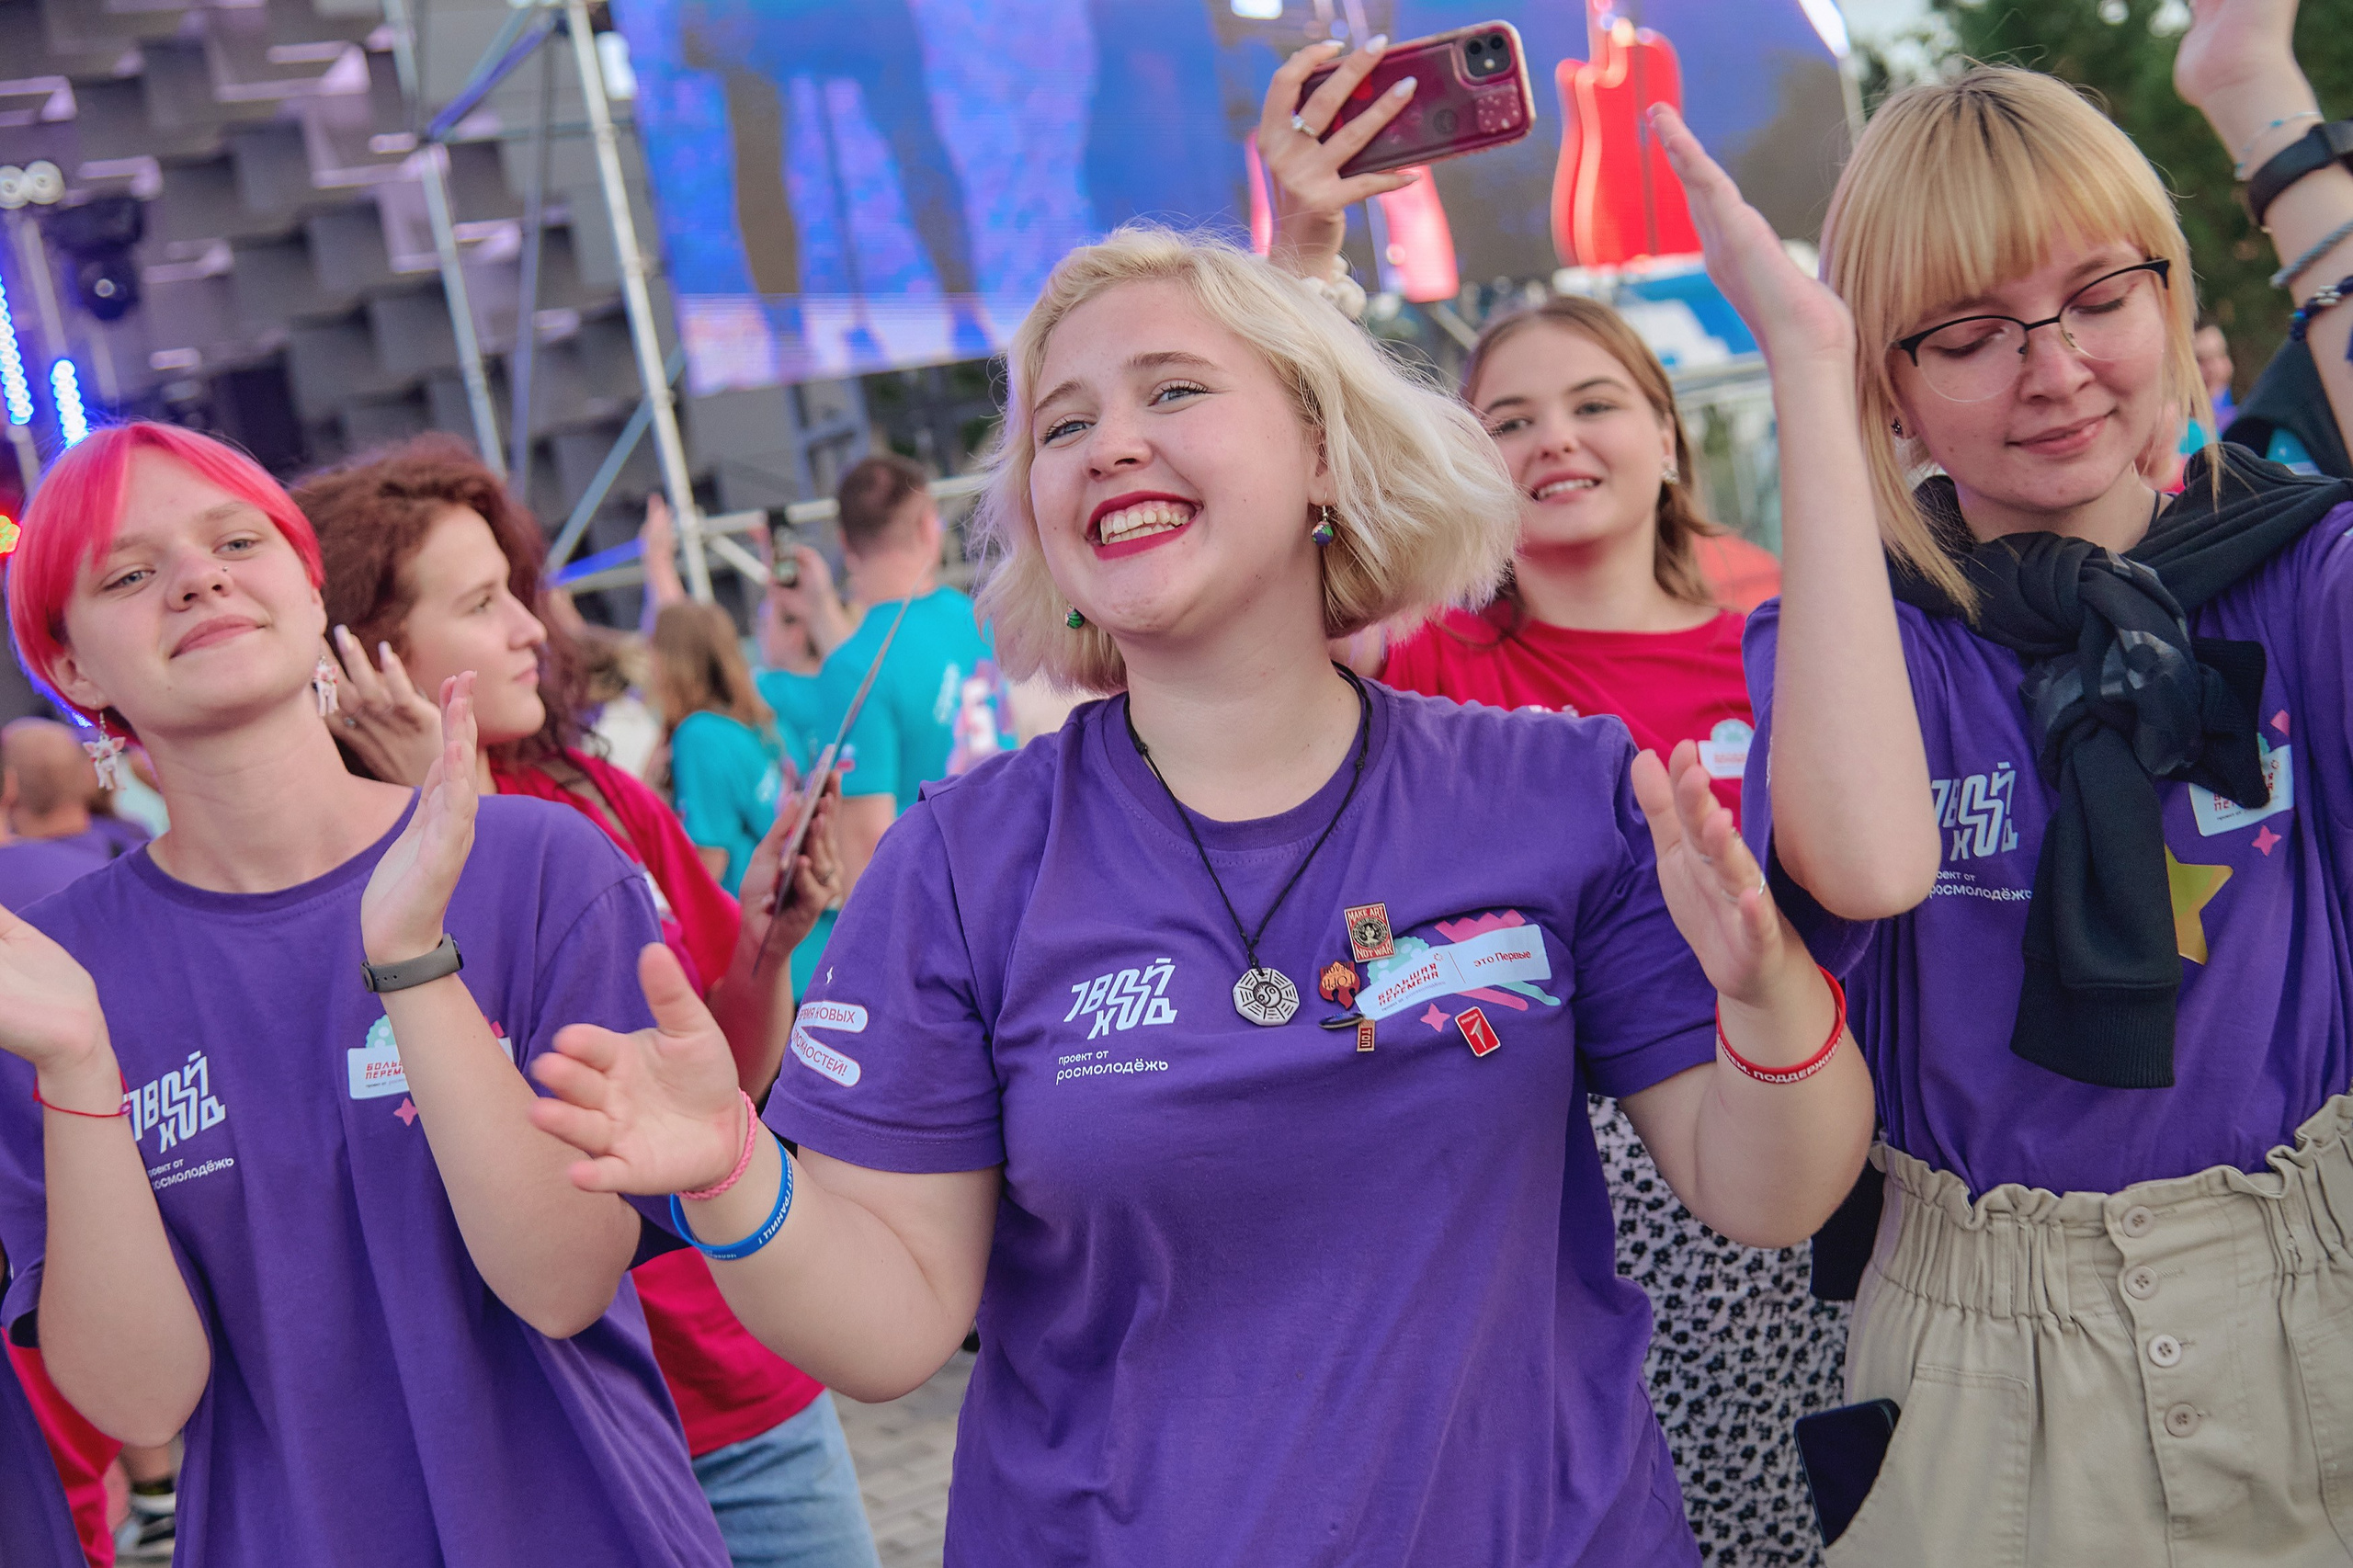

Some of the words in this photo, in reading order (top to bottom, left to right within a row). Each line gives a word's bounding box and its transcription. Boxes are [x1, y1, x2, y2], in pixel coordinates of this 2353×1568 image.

[1963, 873, 1975, 881] от
[1347, 908, 1368, 927] MAKE
[1370, 906, 1385, 921] ART
[1355, 943, 1374, 959] NOT
[1373, 938, 1393, 955] WAR
[1495, 950, 1531, 963] Первые
[1063, 958, 1176, 1022] ТВОЙ
[1378, 962, 1437, 1000] БОЛЬШАЯ
[1379, 971, 1439, 1006] ПЕРЕМЕНА
[1087, 985, 1177, 1040] ХОД
[1059, 1052, 1093, 1066] проект
[1096, 1051, 1108, 1060] от
[1056, 1058, 1169, 1085] росмолодёжь
[173, 1158, 184, 1168] от
